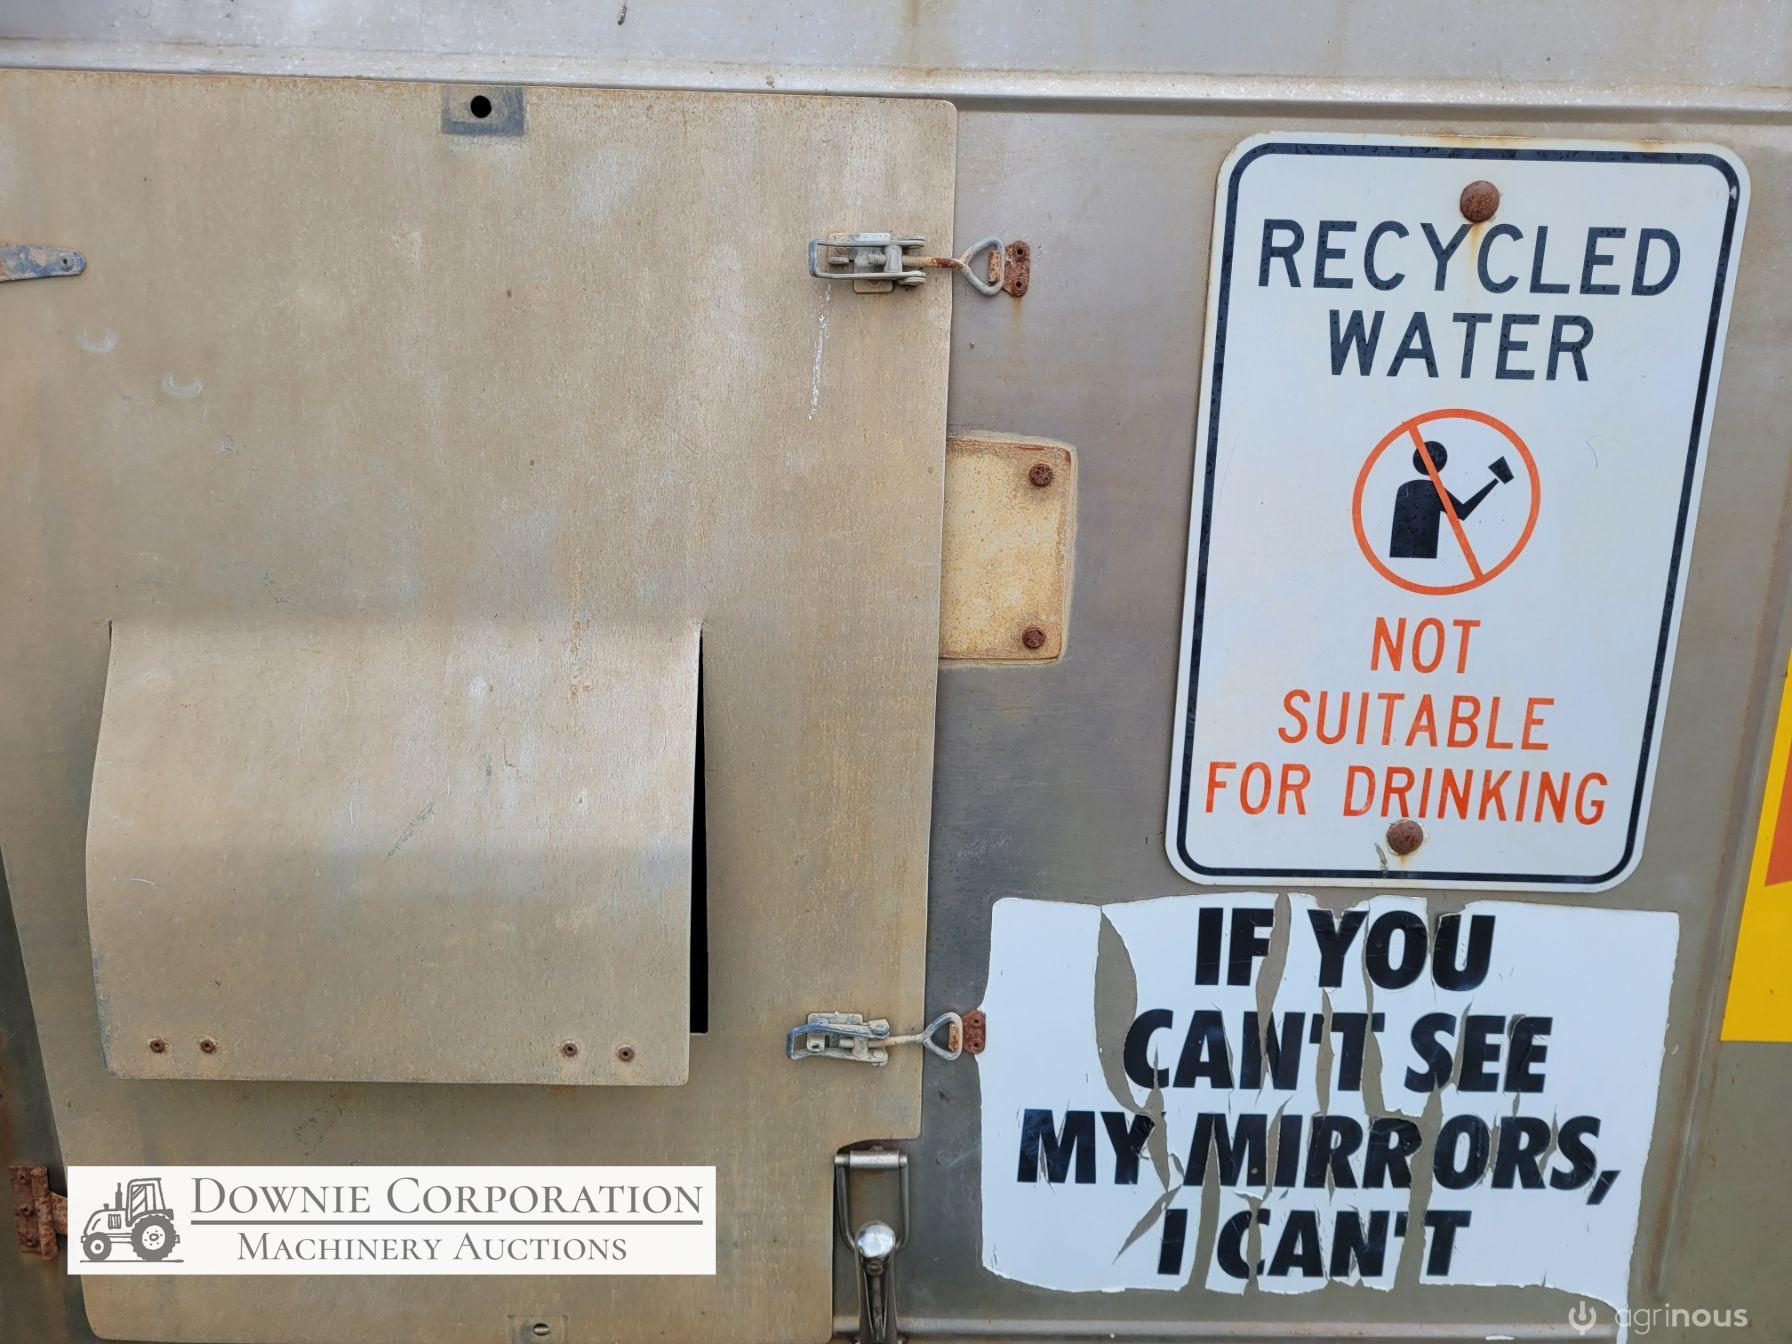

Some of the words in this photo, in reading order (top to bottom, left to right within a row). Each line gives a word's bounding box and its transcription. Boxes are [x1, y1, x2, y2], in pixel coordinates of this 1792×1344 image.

[1258, 218, 1681, 296] RECYCLED
[1328, 309, 1595, 382] WATER
[1370, 616, 1481, 674] NOT
[1278, 689, 1555, 751] SUITABLE
[1204, 761, 1311, 816] FOR
[1343, 765, 1609, 825] DRINKING
[1194, 907, 1275, 987] IF
[1308, 909, 1496, 992] YOU
[1123, 1008, 1385, 1091] CAN'T
[1403, 1012, 1553, 1093] SEE
[1016, 1108, 1165, 1185] MY
[1181, 1112, 1621, 1206] MIRRORS,
[1157, 1207, 1189, 1276] I
[1217, 1209, 1471, 1279] CAN'T
